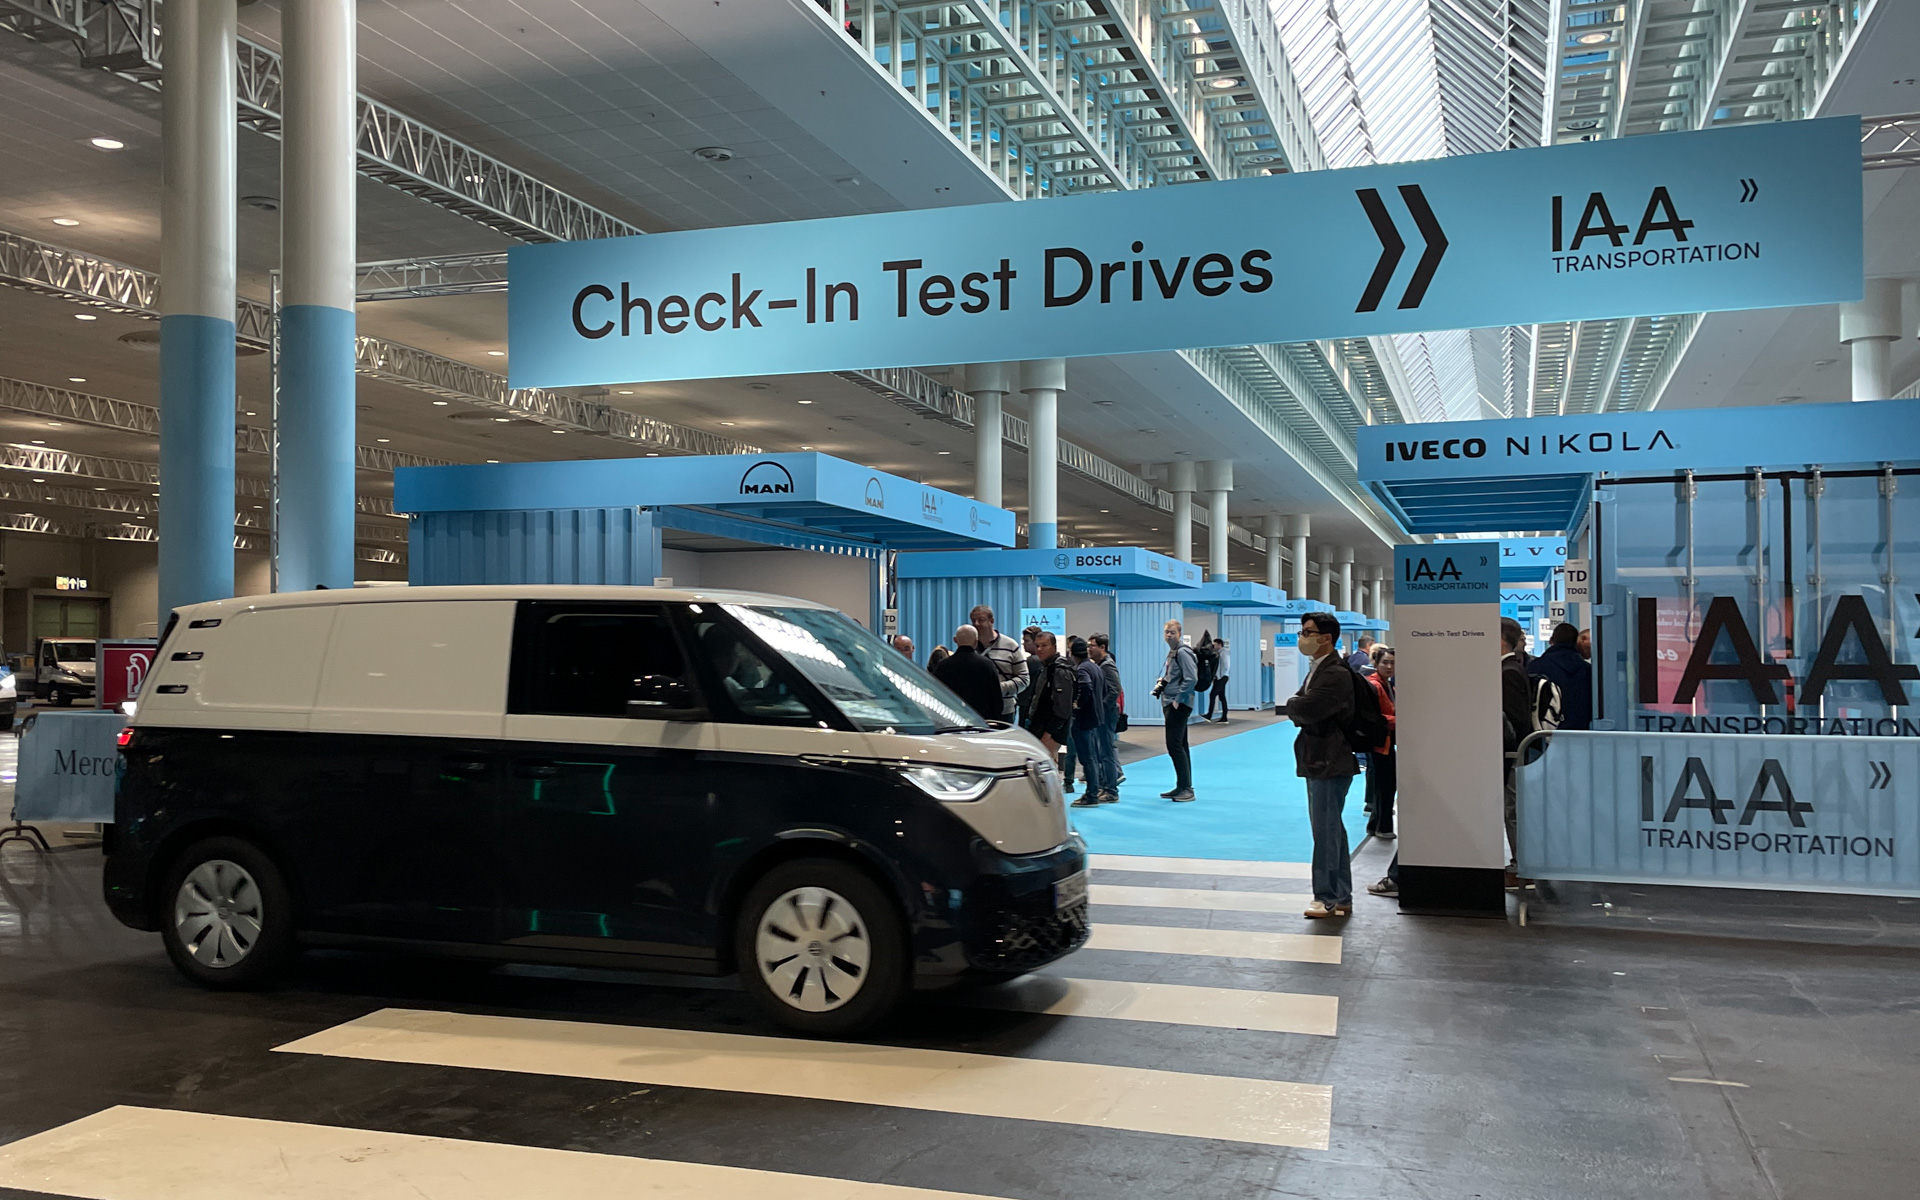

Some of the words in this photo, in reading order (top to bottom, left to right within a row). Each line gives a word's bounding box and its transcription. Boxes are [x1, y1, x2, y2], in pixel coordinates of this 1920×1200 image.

[1551, 185, 1695, 252] IAA
[1552, 241, 1760, 273] TRANSPORTATION
[882, 258, 1017, 318] Test
[1044, 240, 1273, 308] Drives
[1385, 438, 1487, 462] IVECO
[1506, 430, 1674, 457] NIKOLA
[744, 483, 789, 495] MAN
[1076, 555, 1122, 567] BOSCH
[1405, 557, 1463, 582] IAA
[1406, 582, 1489, 591] TRANSPORTATION
[1566, 570, 1587, 582] TD
[1566, 587, 1588, 595] TD02
[1026, 614, 1049, 626] IAA
[1551, 608, 1565, 616] TD
[1637, 594, 1920, 706] IAA
[1640, 755, 1815, 828] IAA
[1642, 827, 1895, 858] TRANSPORTATION
